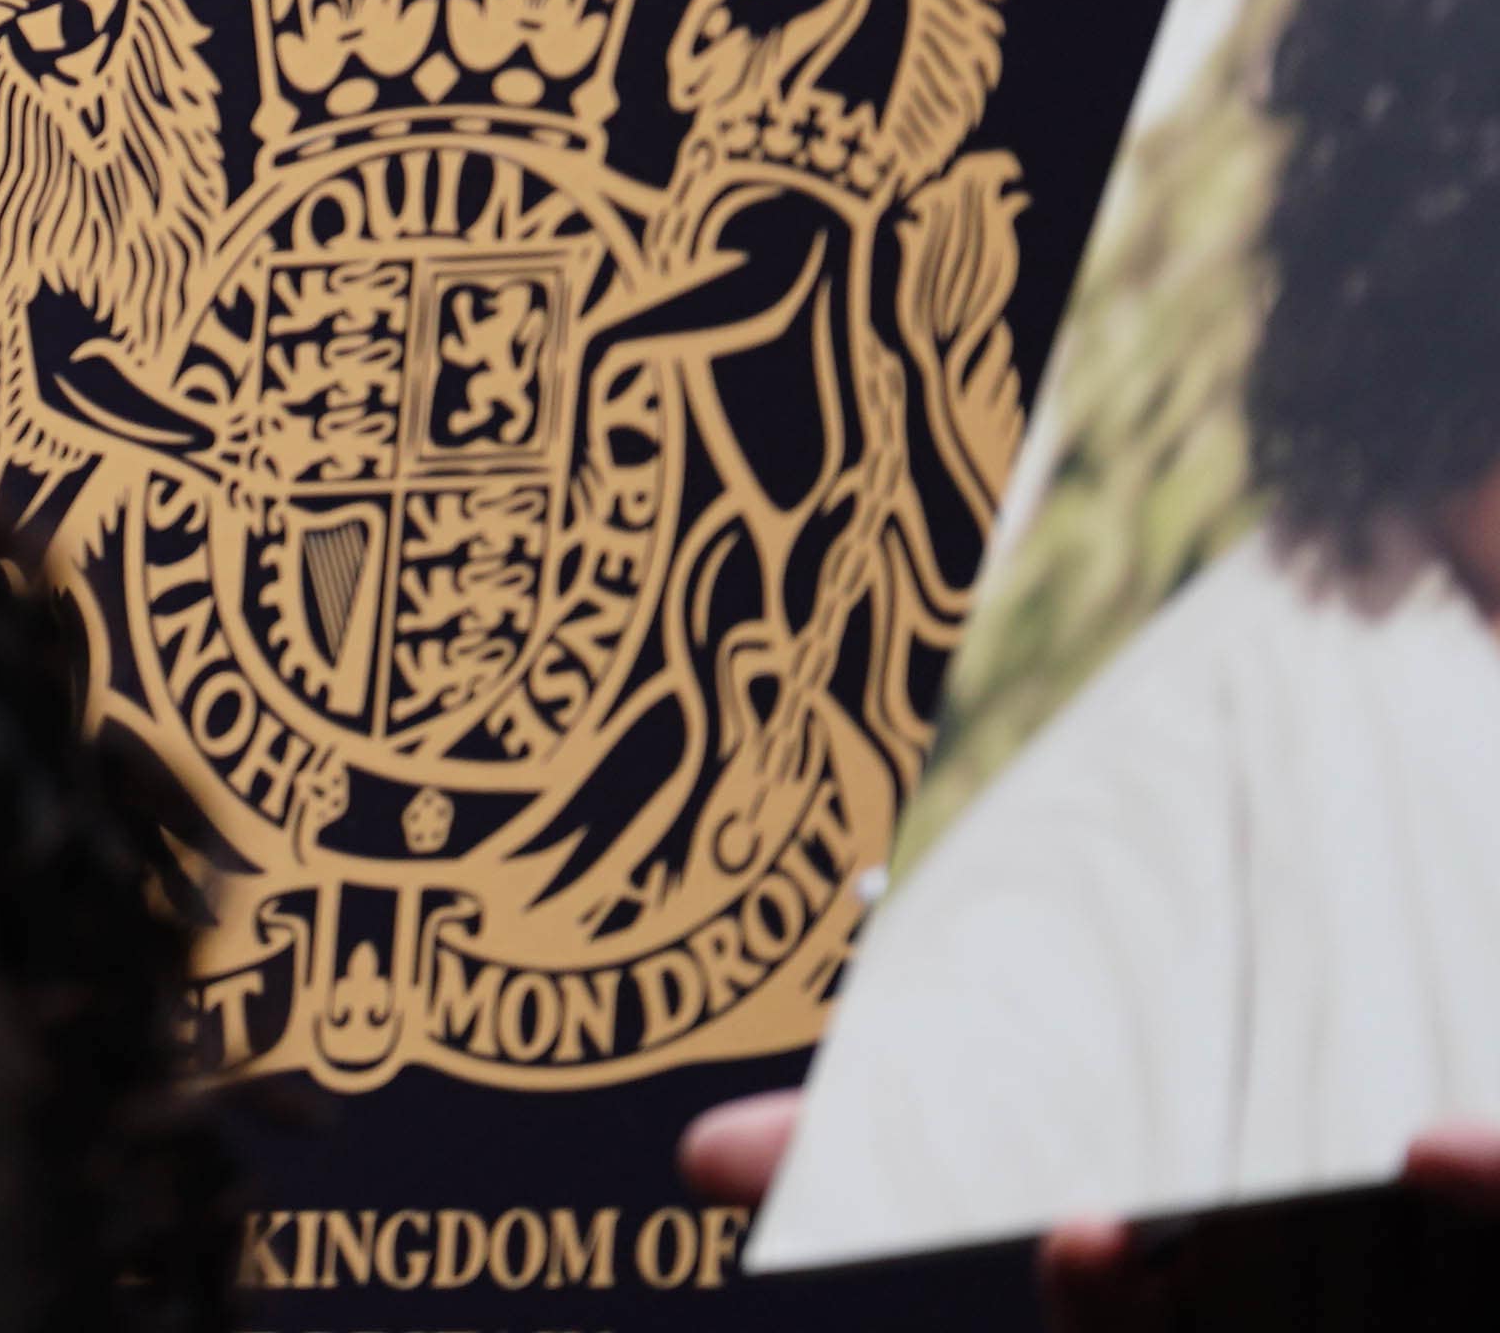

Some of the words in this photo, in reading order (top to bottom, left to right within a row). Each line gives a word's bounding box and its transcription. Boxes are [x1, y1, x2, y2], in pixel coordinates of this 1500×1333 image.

[428, 945, 624, 1065] MON
[628, 781, 856, 1051] DROIT
[236, 1206, 620, 1290] KINGDOM
[634, 1205, 751, 1290] OF
